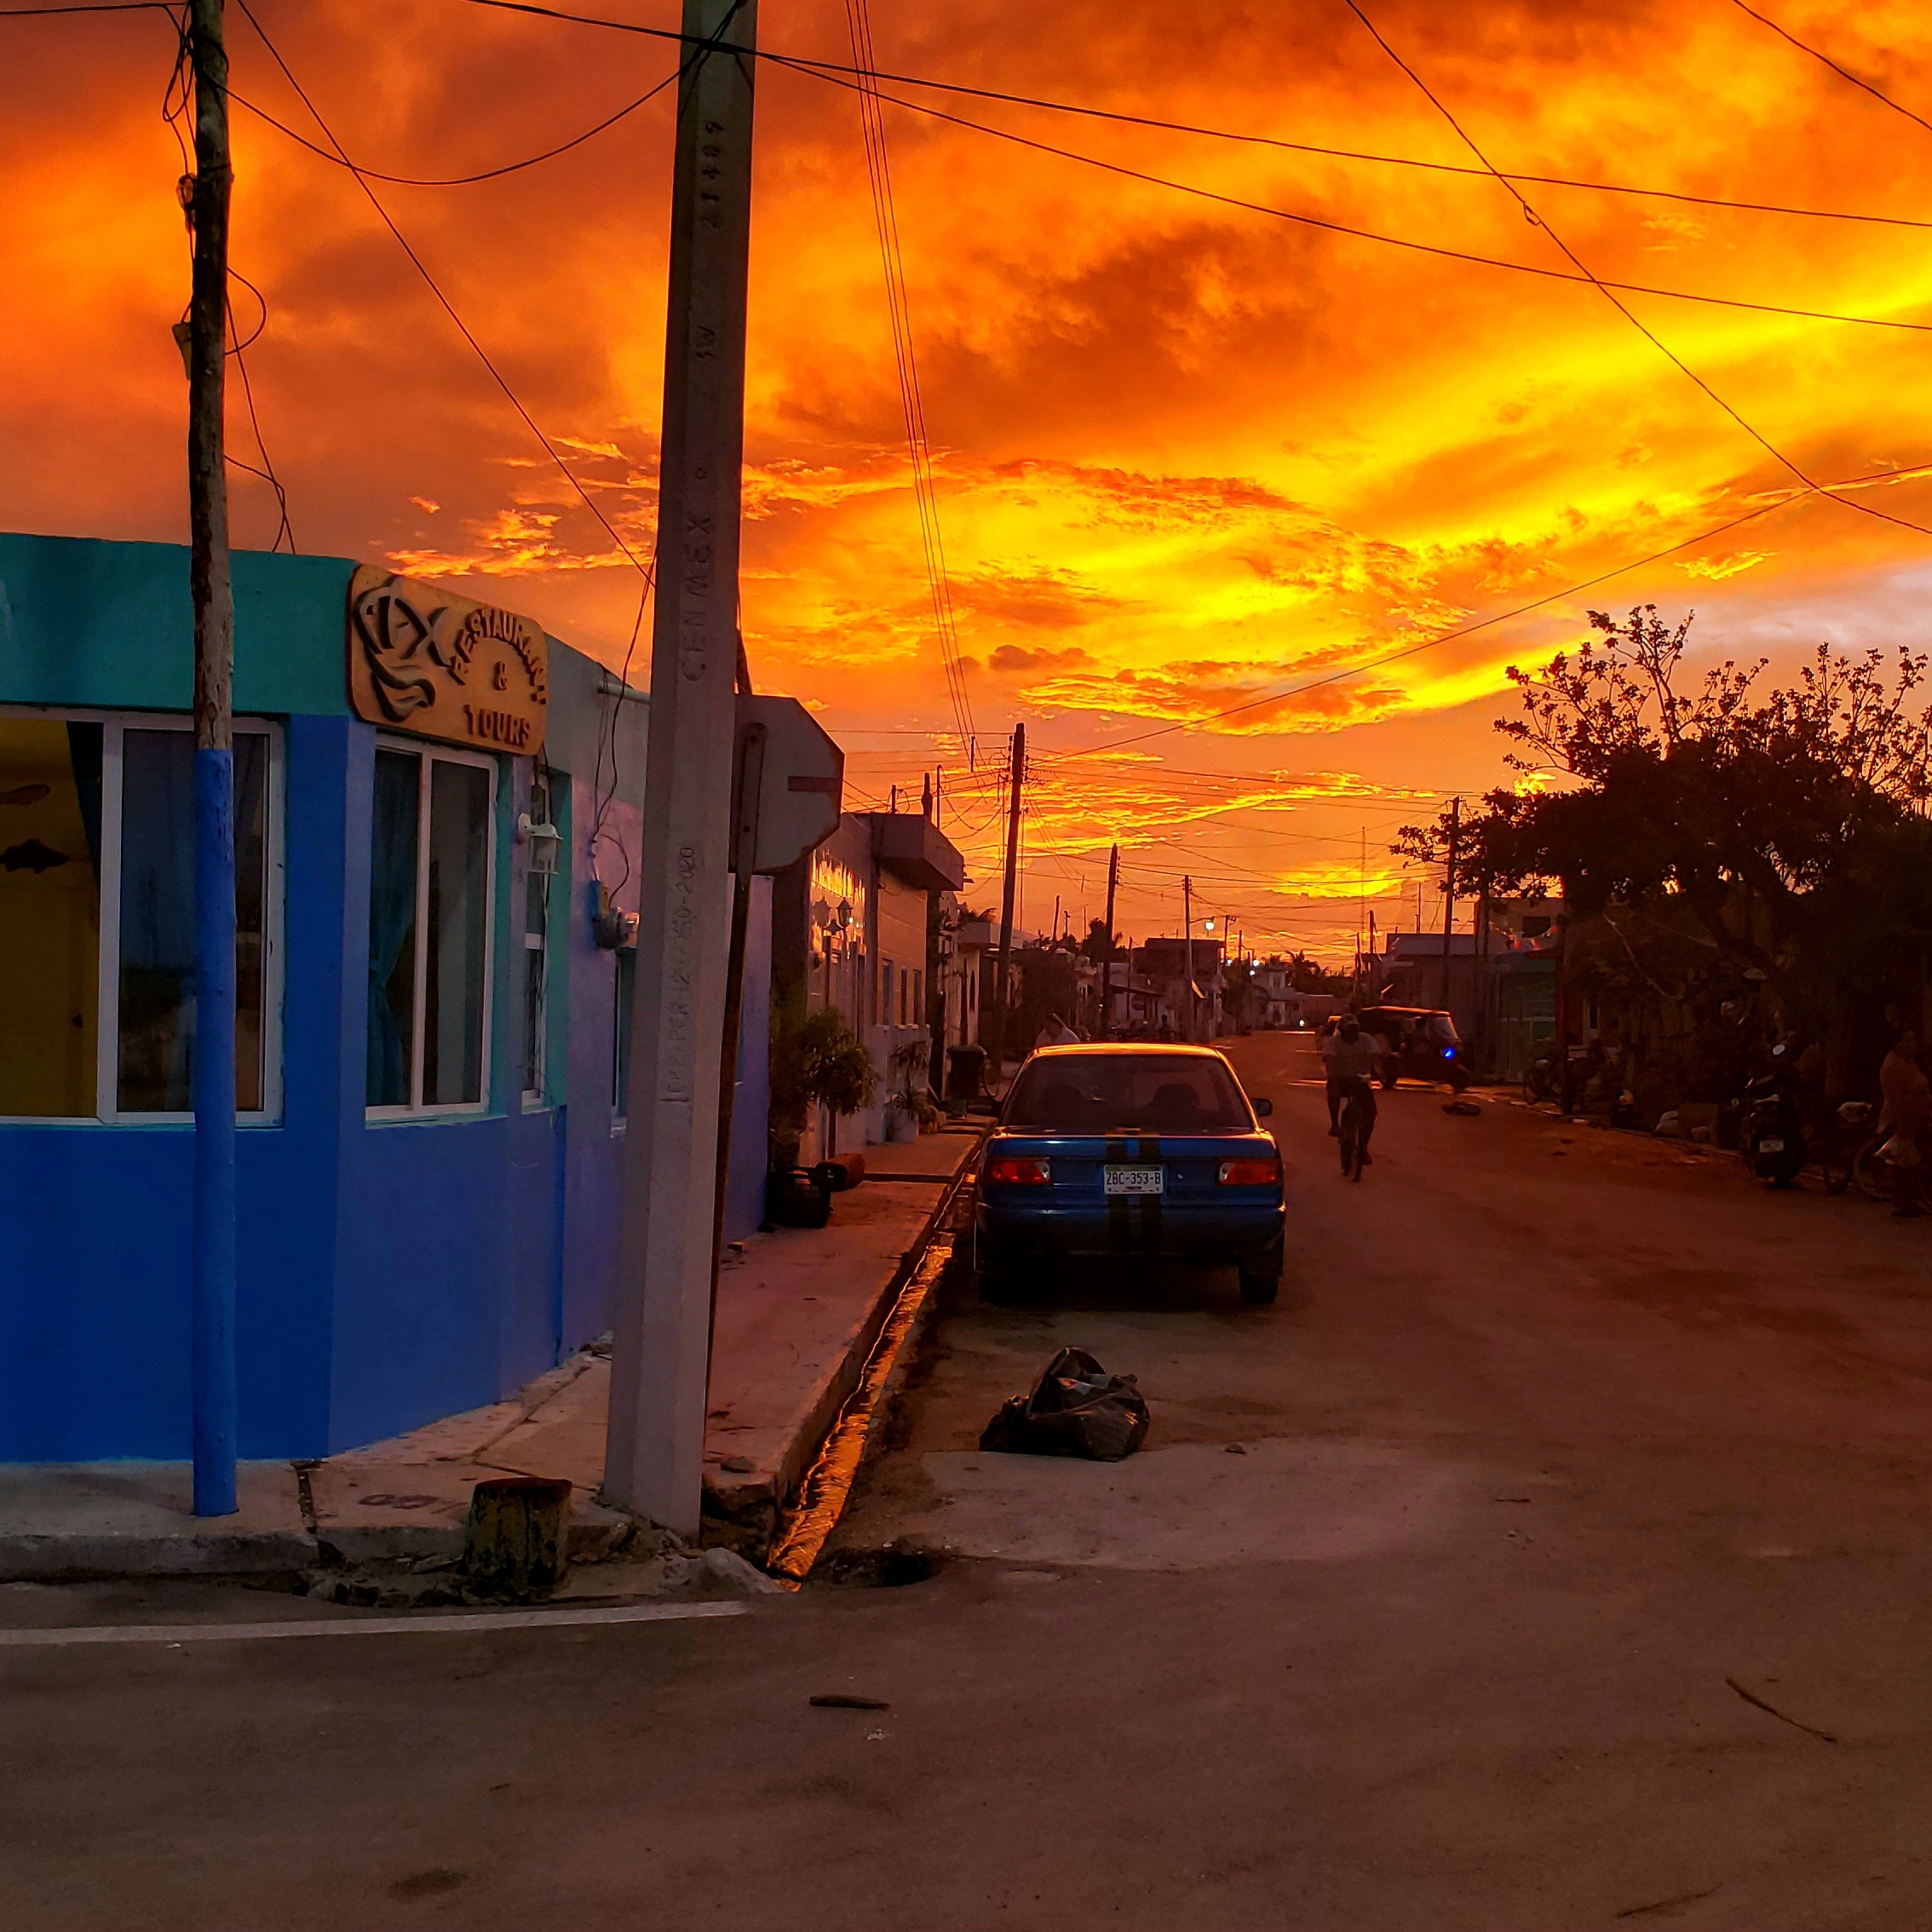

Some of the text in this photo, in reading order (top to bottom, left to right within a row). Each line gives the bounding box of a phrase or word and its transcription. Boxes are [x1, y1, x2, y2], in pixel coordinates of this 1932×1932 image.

[448, 607, 547, 706] RESTAURANT
[492, 661, 508, 692] &
[463, 704, 530, 748] TOURS
[1106, 1171, 1161, 1185] ZBC-353-B
